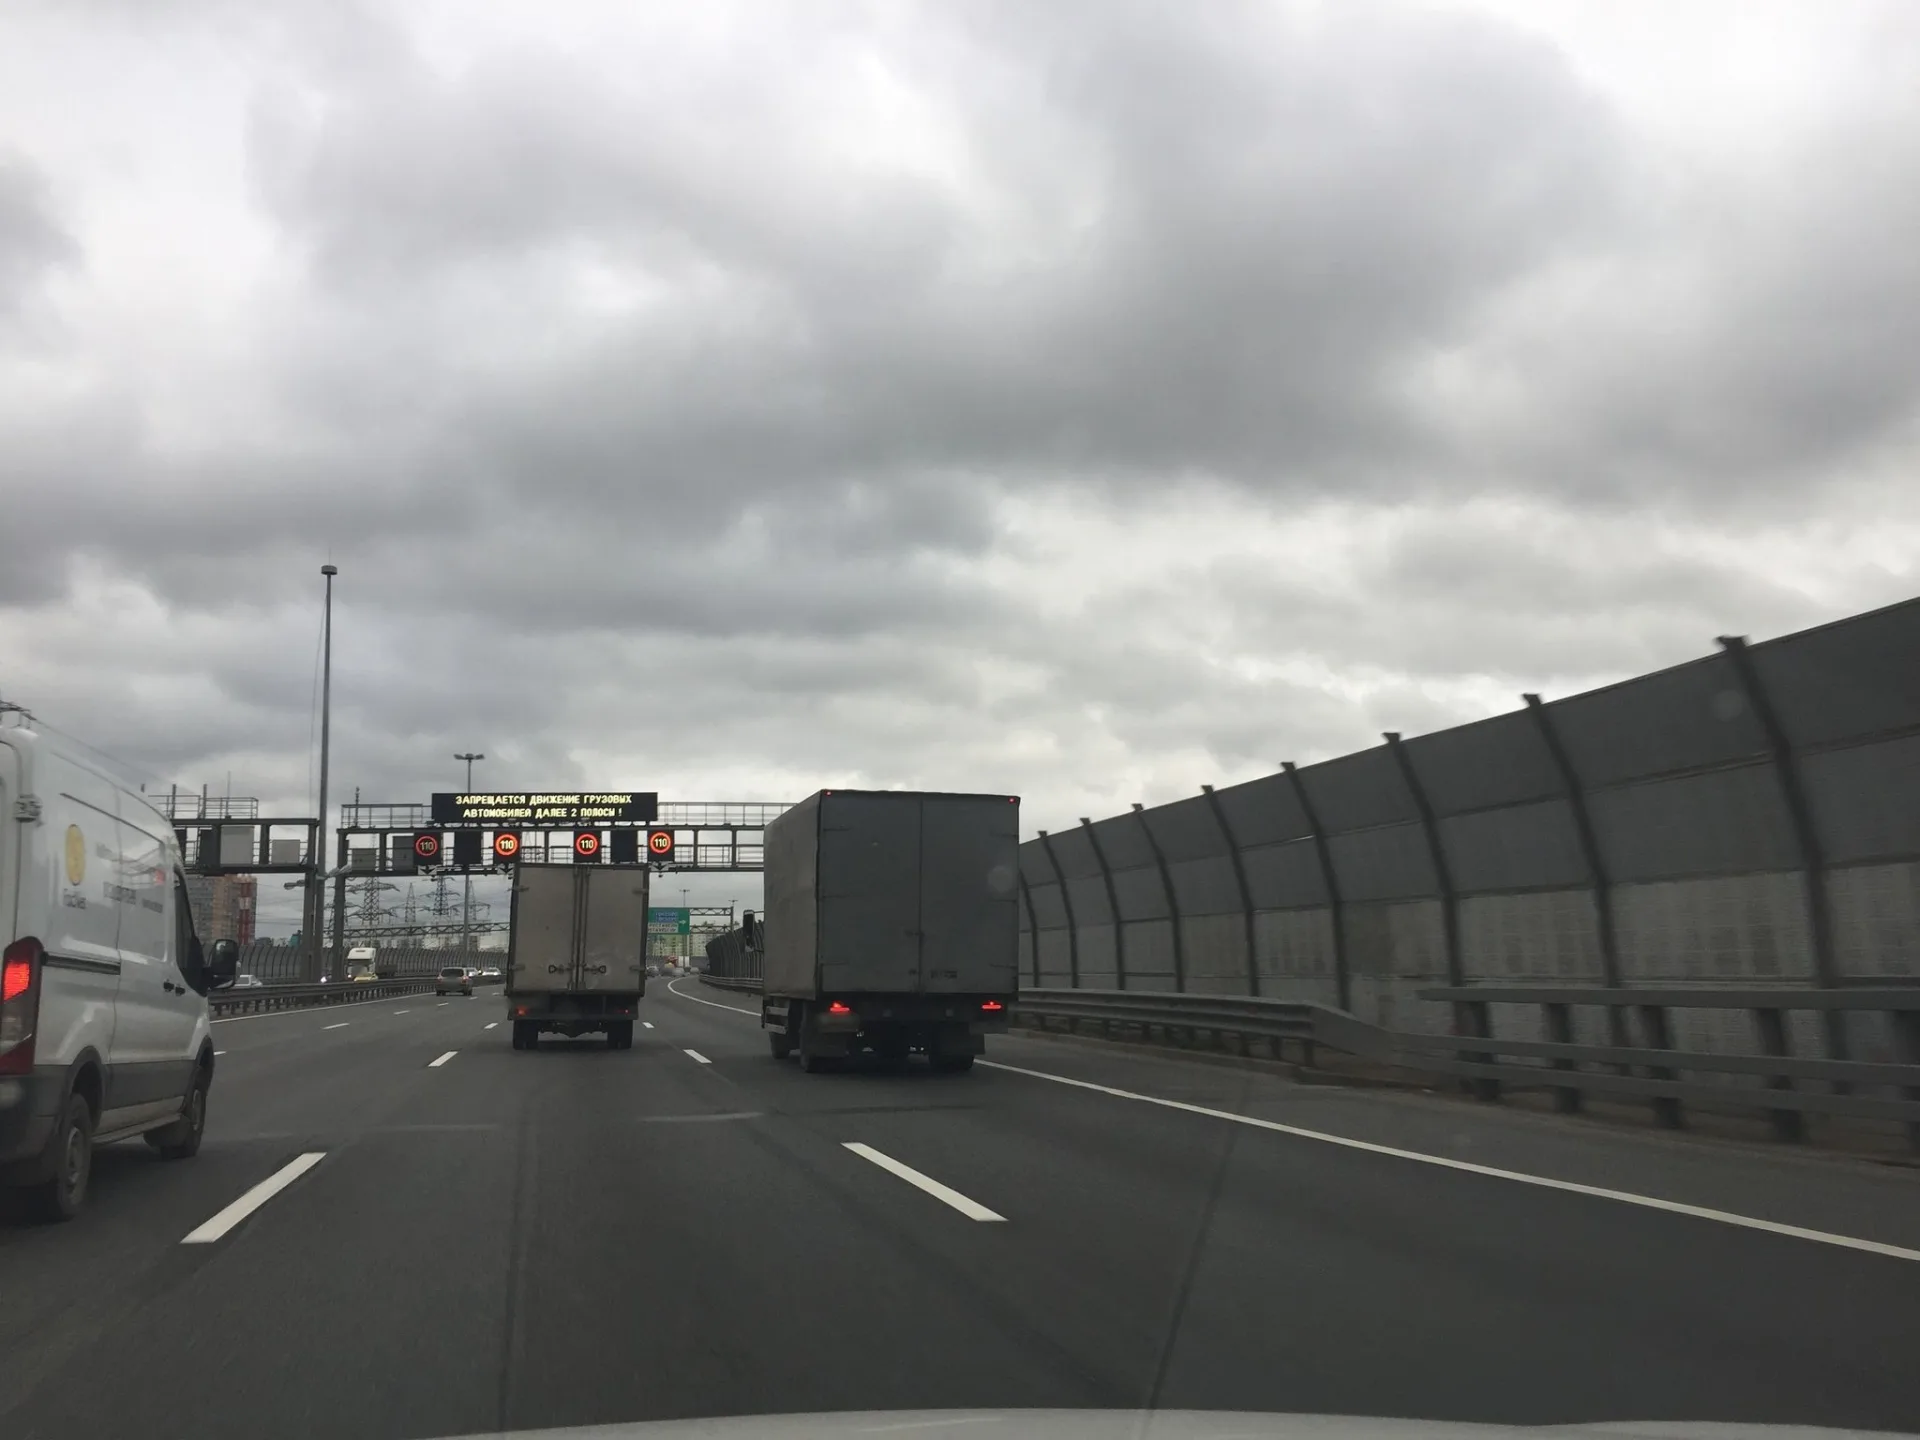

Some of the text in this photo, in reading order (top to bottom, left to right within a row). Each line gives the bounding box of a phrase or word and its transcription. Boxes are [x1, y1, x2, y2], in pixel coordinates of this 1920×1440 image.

[455, 794, 632, 806] ЗАПРЕЩАЕТСЯ ДВИЖЕНИЕ ГРУЗОВЫХ
[463, 808, 532, 818] АВТОМОБИЛЕЙ
[535, 807, 567, 818] ДАЛЕЕ
[570, 808, 577, 817] 2
[580, 807, 616, 817] ПОЛОСЫ
[419, 841, 434, 851] 110
[500, 840, 514, 850] 110
[580, 839, 594, 849] 110
[654, 838, 667, 848] 110
